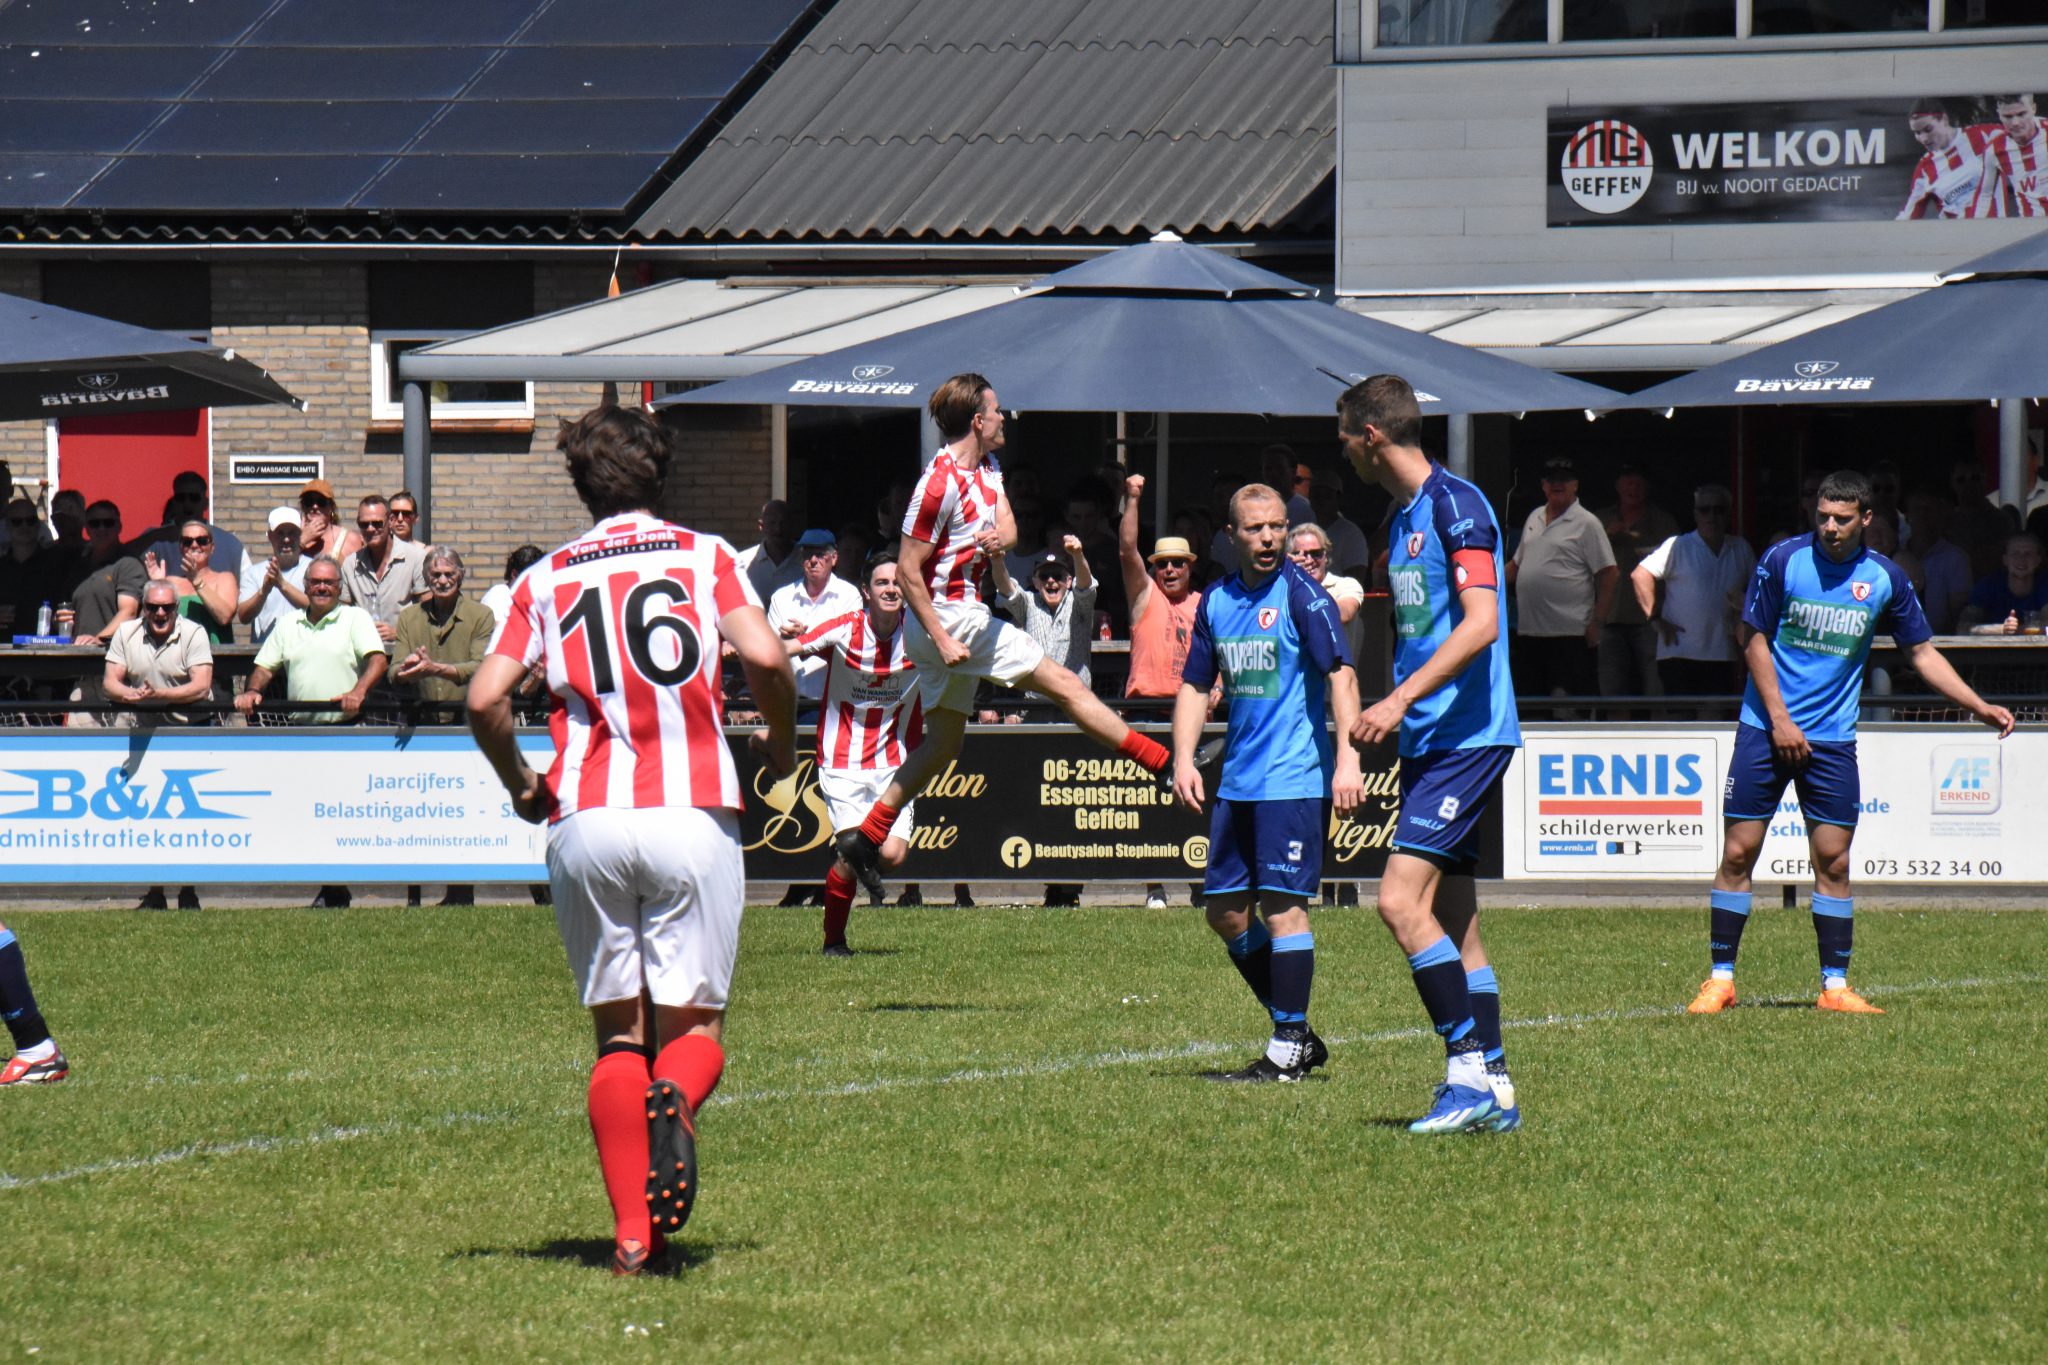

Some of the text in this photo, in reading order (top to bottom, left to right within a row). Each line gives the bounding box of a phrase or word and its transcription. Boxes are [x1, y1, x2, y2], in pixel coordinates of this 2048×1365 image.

[1671, 128, 1886, 169] WELKOM
[1571, 176, 1641, 196] GEFFEN
[1676, 180, 1697, 195] BIJ
[1724, 178, 1779, 194] NOOIT
[1783, 176, 1862, 192] GEDACHT
[788, 380, 914, 394] Bavaria
[1734, 379, 1872, 392] Bavaria
[261, 466, 290, 474] MASSAGE
[568, 530, 676, 555] Van der Donk
[569, 541, 678, 564] sierbestrating
[1788, 601, 1867, 640] coppens
[559, 578, 700, 695] 16
[1793, 638, 1850, 656] WARENHUIS
[1043, 759, 1156, 781] 06-294424
[1539, 753, 1702, 796] ERNIS
[366, 773, 465, 793] Jaarcijfers
[0, 767, 251, 821] B&A
[1041, 784, 1157, 805] Essenstraat
[1940, 791, 1990, 801] ERKEND
[314, 802, 465, 822] Belastingadvies
[1438, 795, 1460, 821] 8
[1075, 808, 1139, 829] Geffen
[1539, 819, 1703, 835] schilderwerken
[0, 829, 252, 848] dministratiekantoor
[336, 835, 508, 847] www.ba-administratie.nl
[1542, 841, 1595, 852] www.ernis.nl
[1035, 843, 1179, 859] Beautysalon Stephanie
[1288, 840, 1303, 861] 3
[1865, 860, 1898, 875] 073
[1906, 860, 1941, 875] 532
[1949, 861, 1971, 875] 34
[1979, 861, 2002, 876] 00
